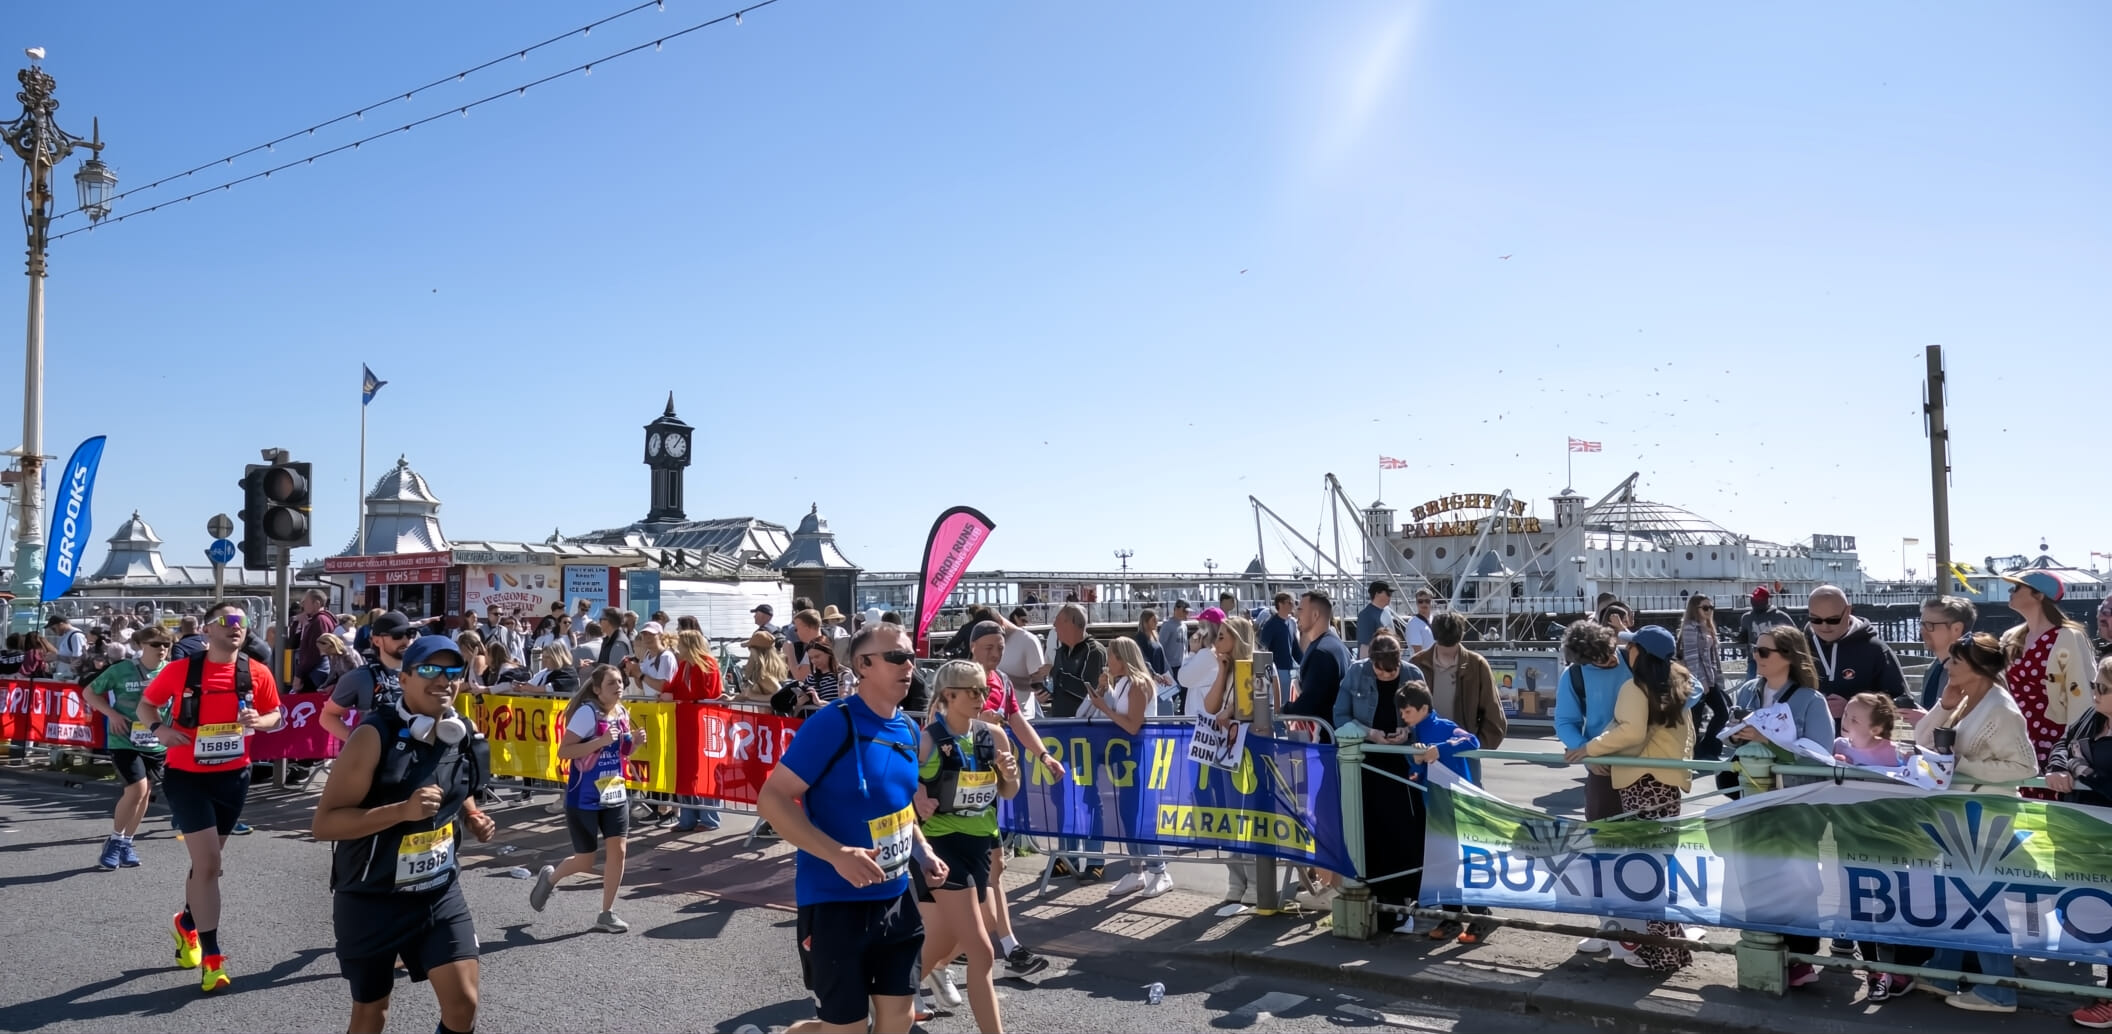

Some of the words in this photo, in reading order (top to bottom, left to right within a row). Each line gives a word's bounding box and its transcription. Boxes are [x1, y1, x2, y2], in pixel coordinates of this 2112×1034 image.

[57, 462, 88, 578] BROOKS
[1410, 493, 1528, 522] BRIGHTON
[963, 526, 983, 551] CLUB
[1401, 520, 1479, 539] PALACE
[930, 552, 954, 589] FORDY
[952, 522, 975, 553] RUNS
[48, 722, 92, 741] MARATHON
[201, 740, 239, 753] 15895
[1190, 745, 1215, 762] RUN
[1161, 809, 1315, 847] MARATHON
[1461, 844, 1708, 906] BUXTON
[1891, 855, 1953, 870] BRITISH
[1994, 866, 2057, 881] NATURAL
[2064, 871, 2112, 883] MINER
